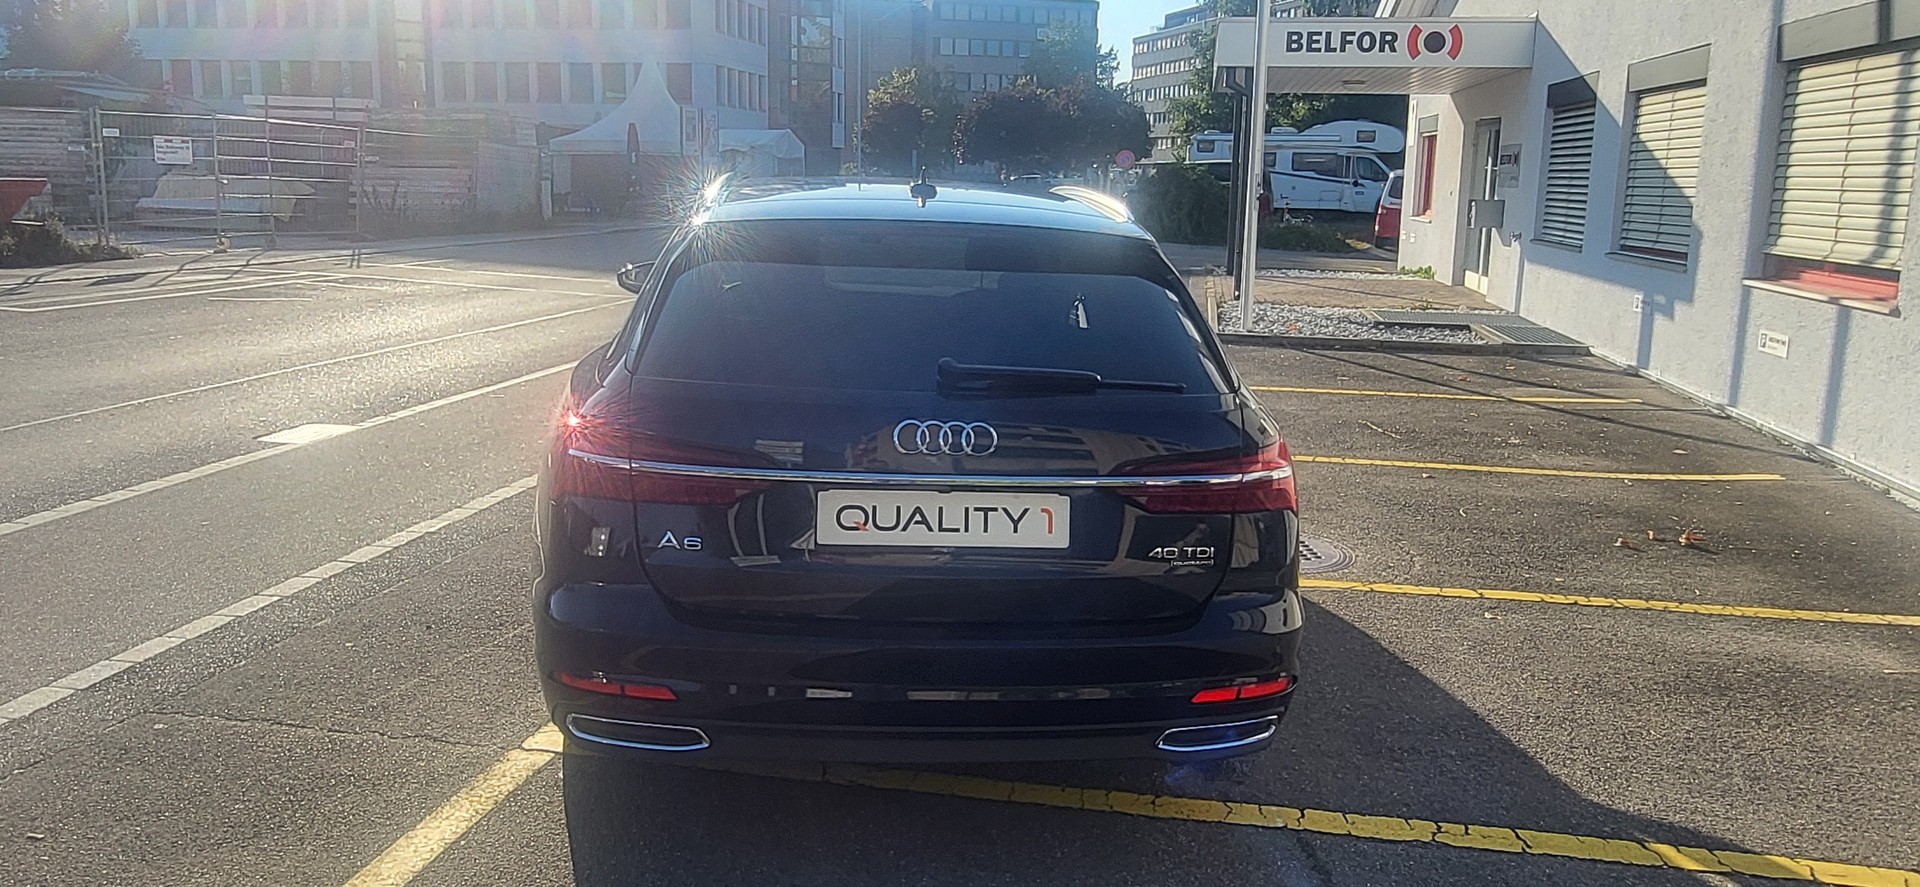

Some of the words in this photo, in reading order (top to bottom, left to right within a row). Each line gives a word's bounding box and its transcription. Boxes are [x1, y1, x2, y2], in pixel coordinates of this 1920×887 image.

[1286, 31, 1398, 53] BELFOR
[836, 505, 1030, 533] QUALITY
[1041, 508, 1053, 534] 1
[657, 531, 702, 550] A6
[1149, 547, 1178, 558] 40
[1183, 547, 1214, 557] TDI
